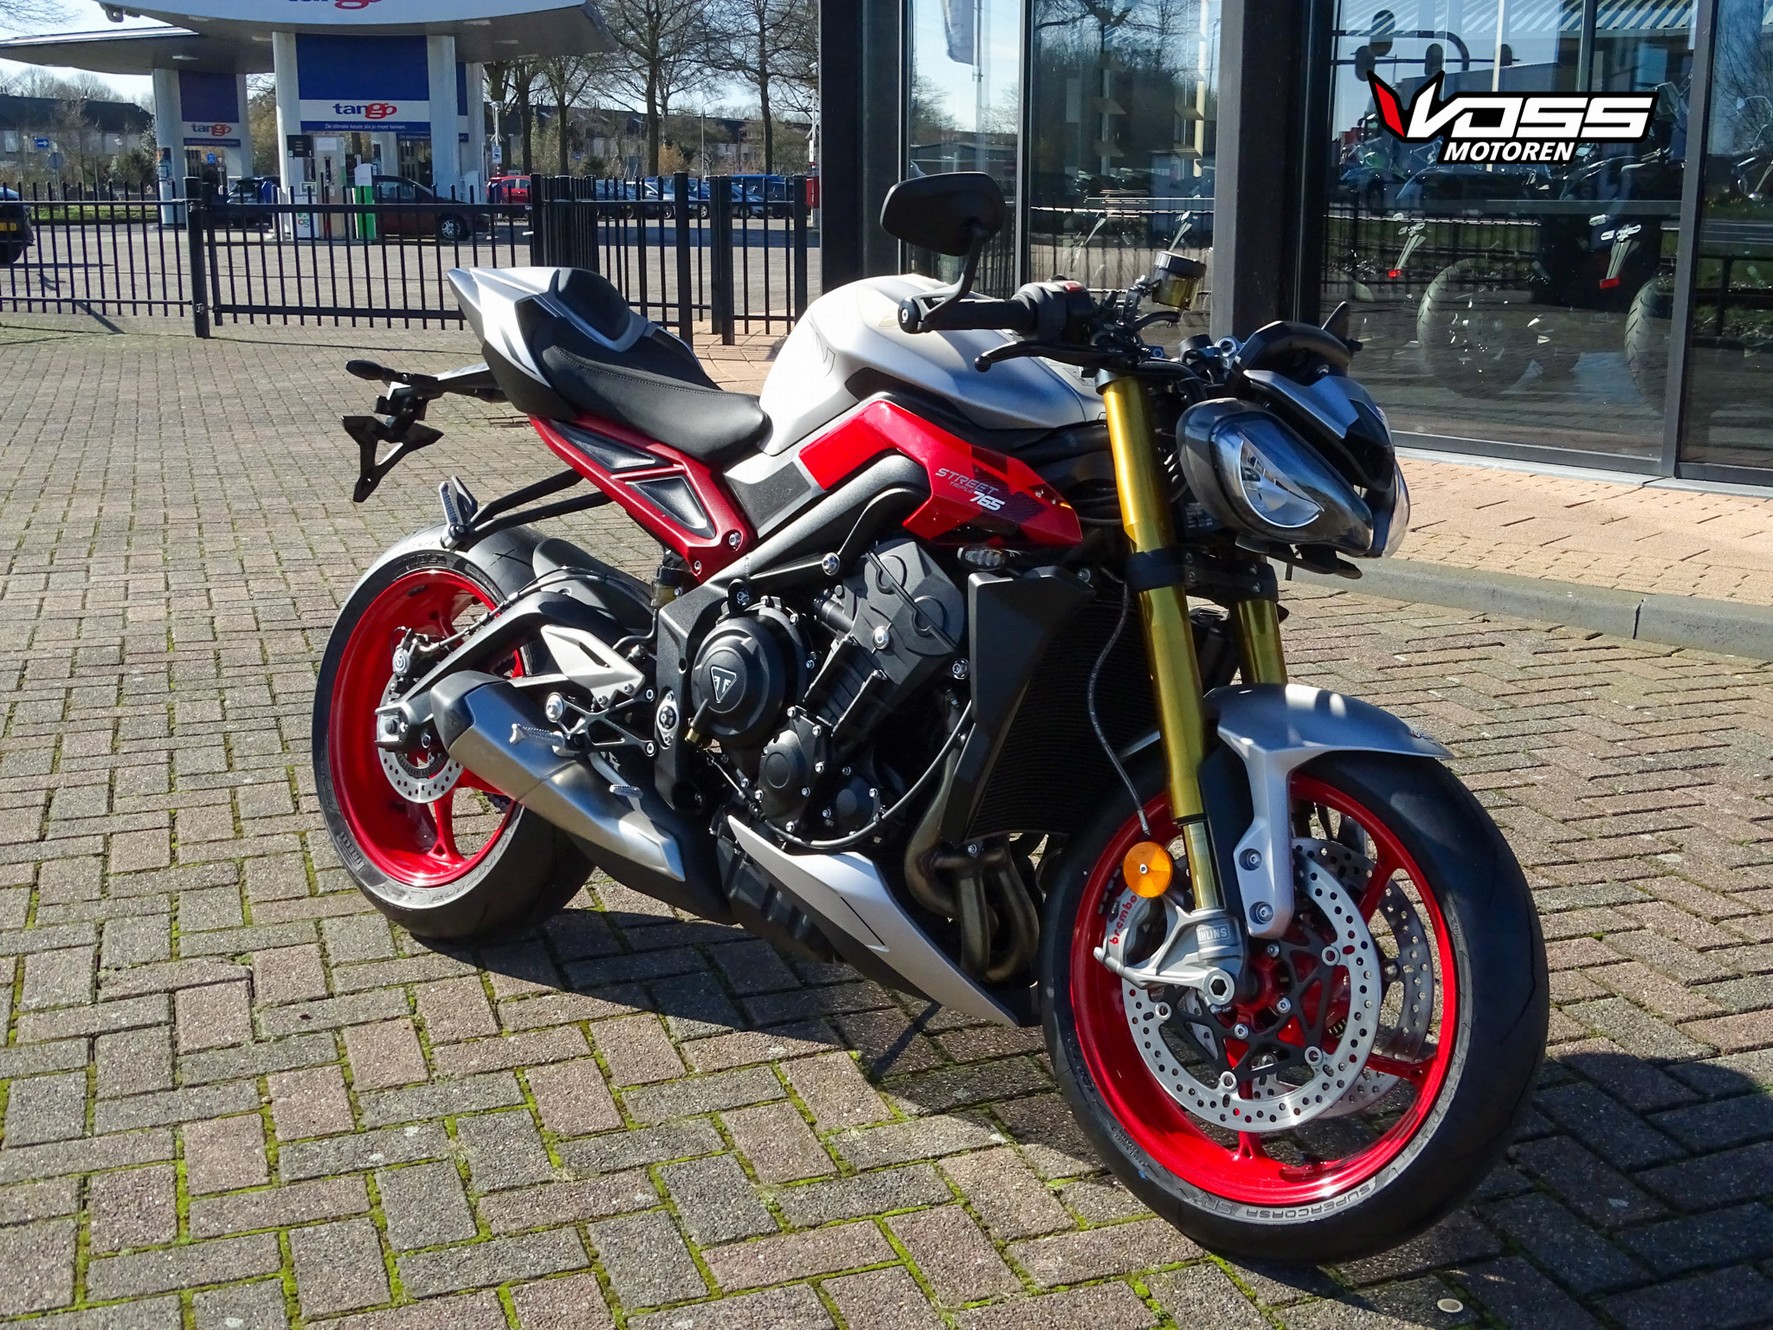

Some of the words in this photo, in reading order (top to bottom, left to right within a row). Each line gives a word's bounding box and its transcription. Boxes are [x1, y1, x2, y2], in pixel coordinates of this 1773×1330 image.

[333, 102, 397, 119] tango
[191, 123, 232, 137] tango
[935, 467, 999, 495] STREET
[969, 490, 1006, 511] 765
[1109, 895, 1137, 945] brembo
[1245, 1183, 1371, 1219] SUPERCORSA
